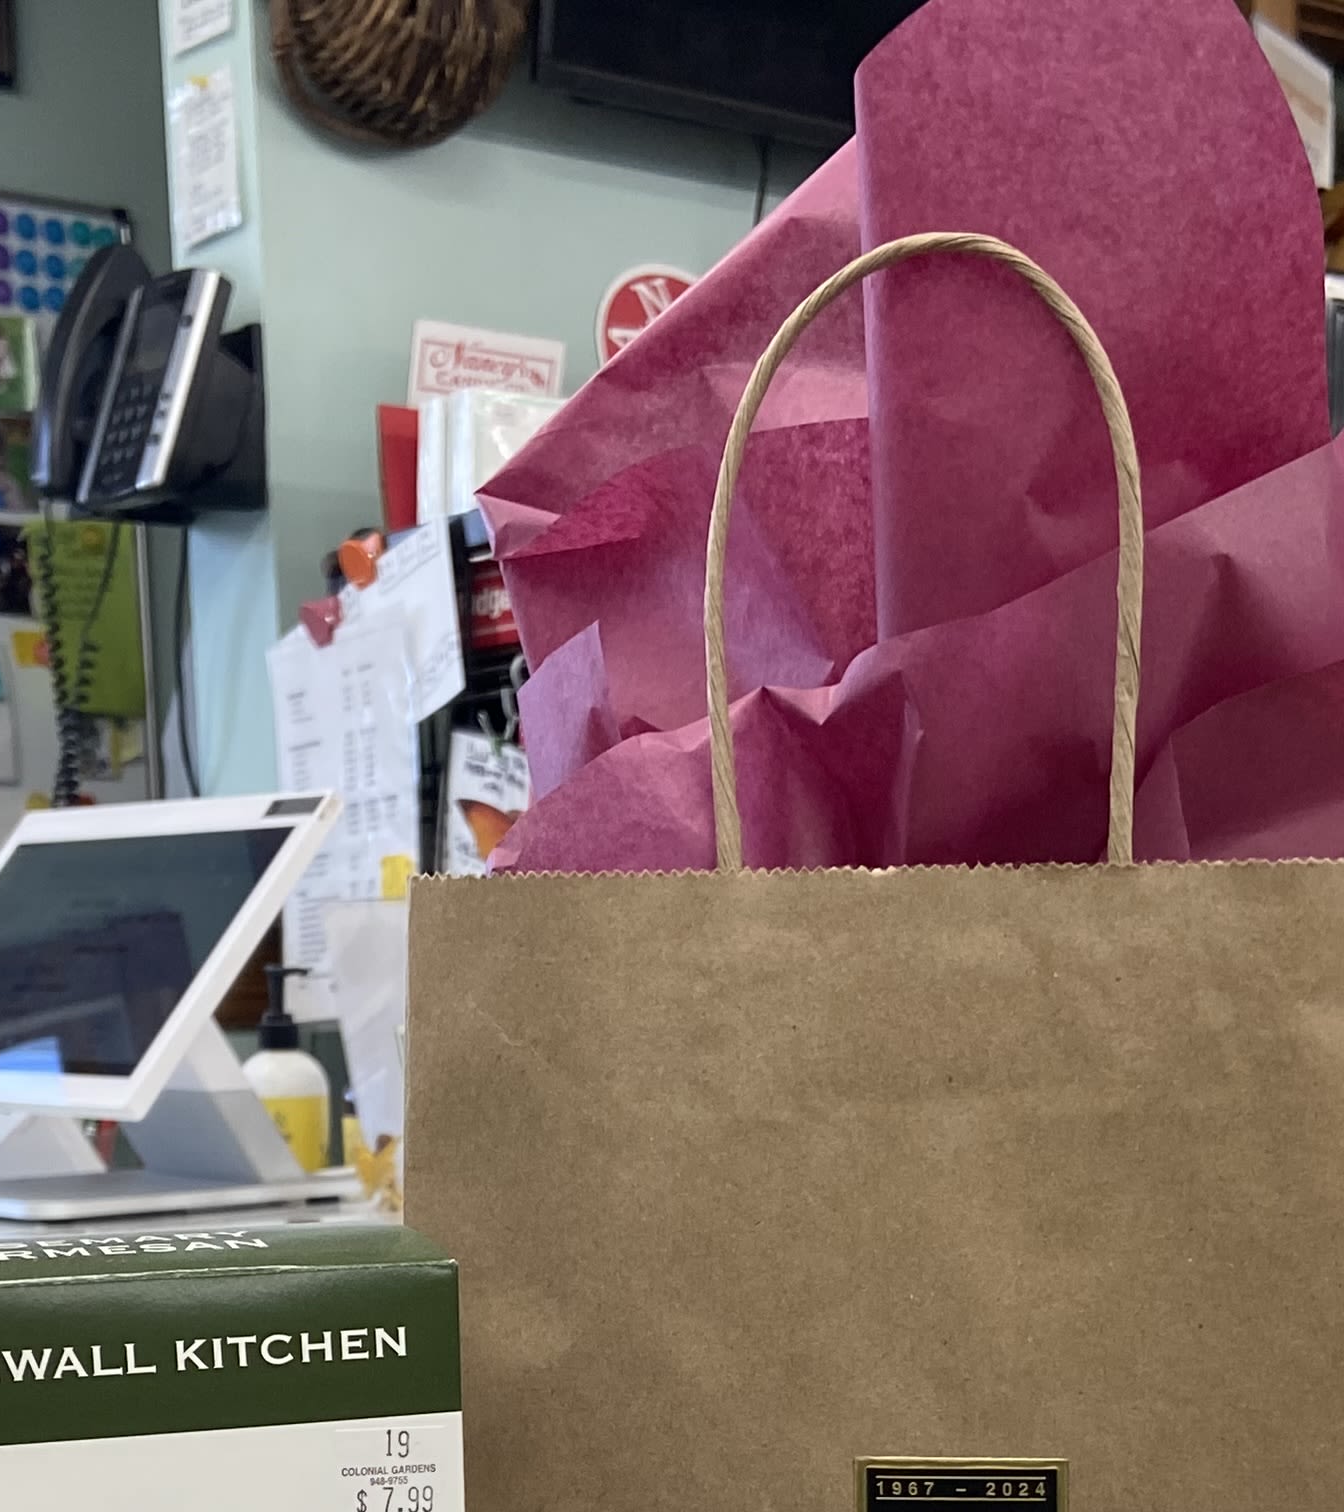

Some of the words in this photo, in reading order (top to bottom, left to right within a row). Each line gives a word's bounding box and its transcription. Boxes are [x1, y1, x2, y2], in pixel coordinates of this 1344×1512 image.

[175, 1326, 408, 1372] KITCHEN
[386, 1429, 410, 1458] 19
[341, 1465, 388, 1477] COLONIAL
[391, 1463, 437, 1475] GARDENS
[876, 1481, 935, 1496] 1967
[985, 1482, 1046, 1497] 2024
